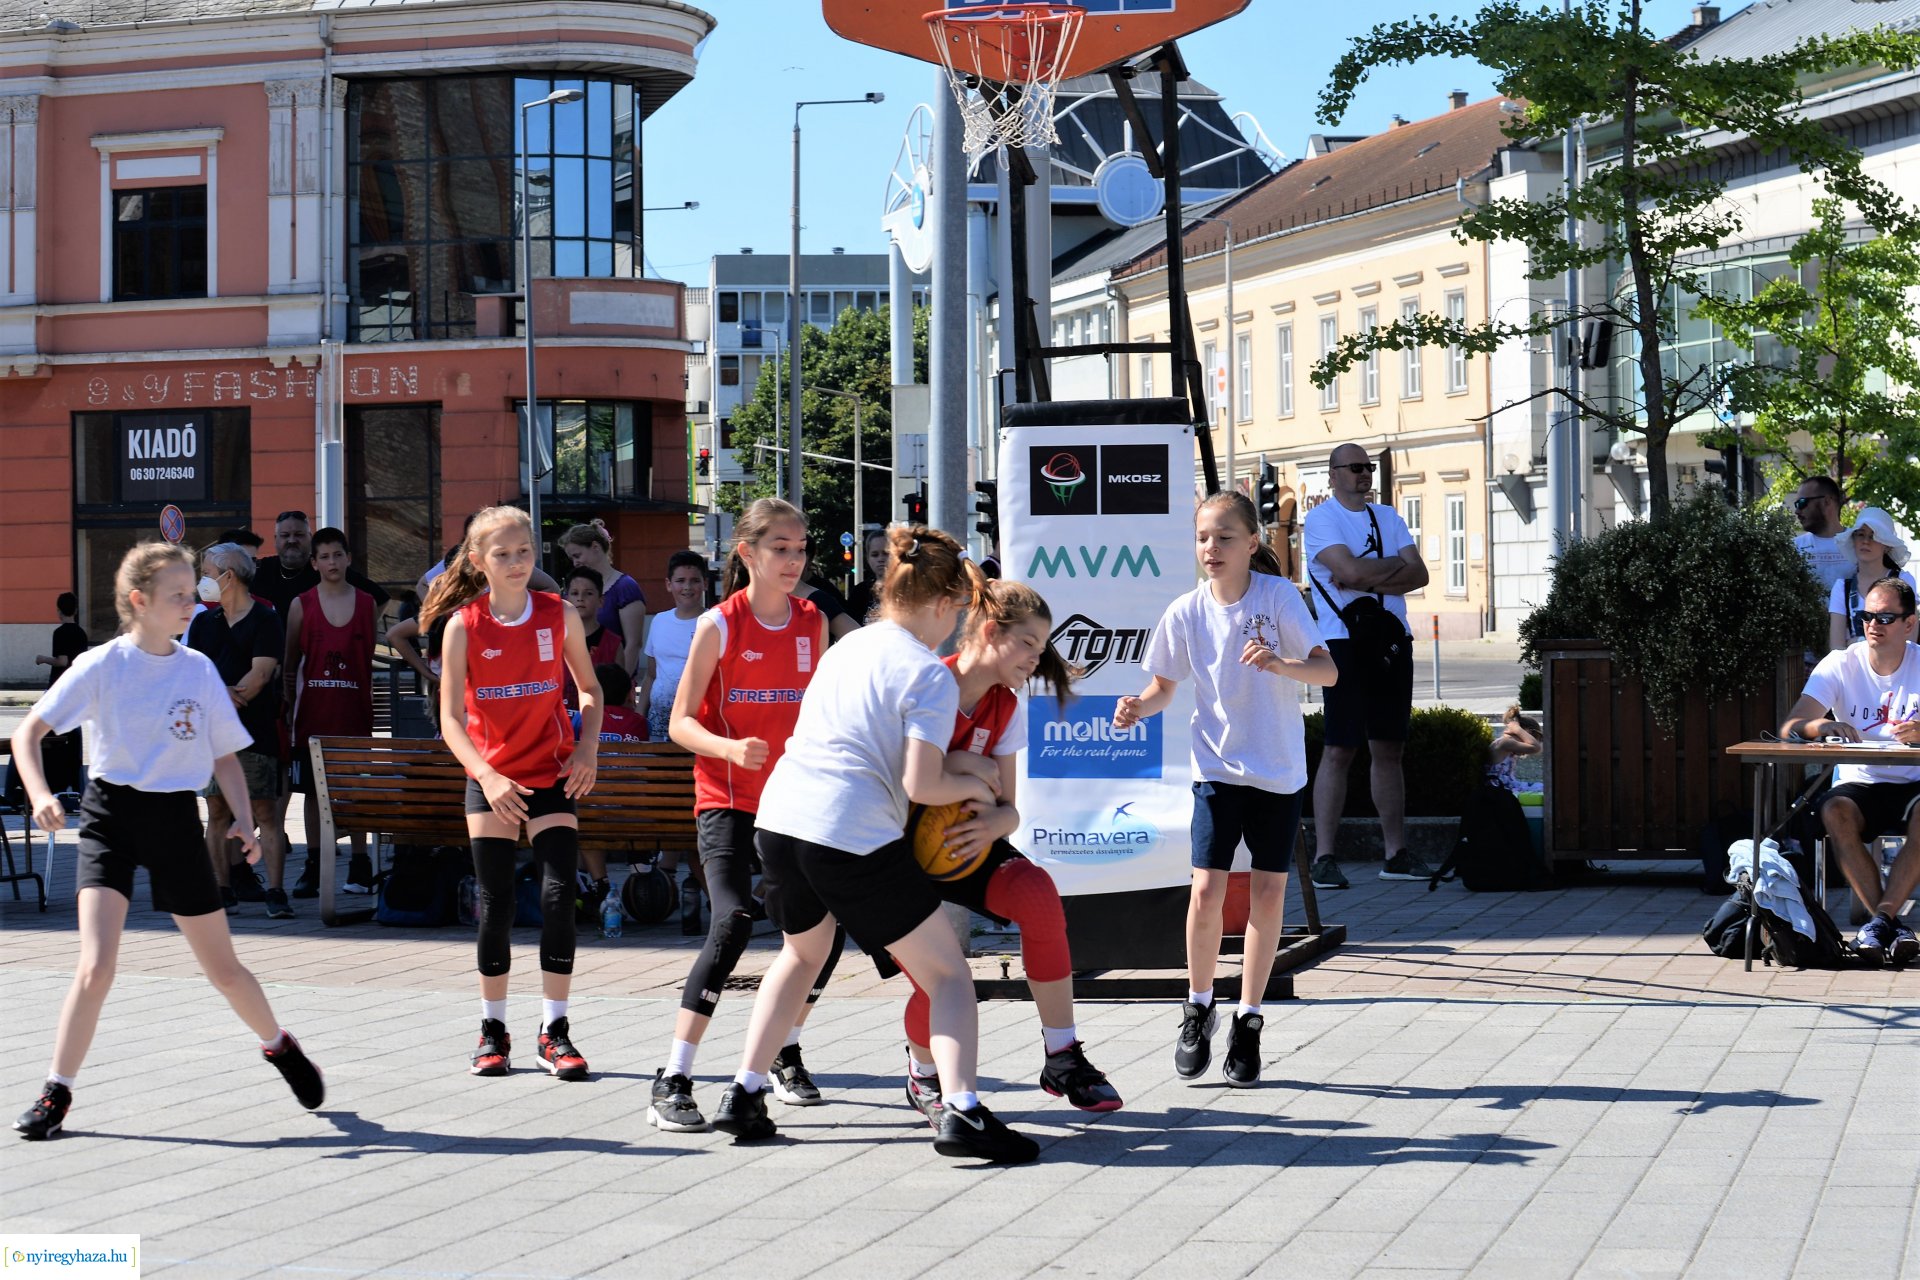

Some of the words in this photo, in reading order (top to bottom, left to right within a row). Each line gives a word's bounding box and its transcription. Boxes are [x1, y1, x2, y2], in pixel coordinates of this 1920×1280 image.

[184, 366, 417, 401] FASHON
[128, 423, 197, 459] KIADÓ
[1108, 474, 1162, 483] MKOSZ
[1027, 545, 1161, 579] MVM
[1065, 627, 1151, 664] TOTI
[308, 679, 359, 689] STREETBALL
[729, 688, 806, 703] STREETBA
[1044, 717, 1147, 741] molten
[1040, 745, 1061, 758] For
[1062, 745, 1083, 757] the
[1084, 745, 1112, 757] real
[1111, 749, 1147, 761] game
[1033, 828, 1150, 846] Primavera
